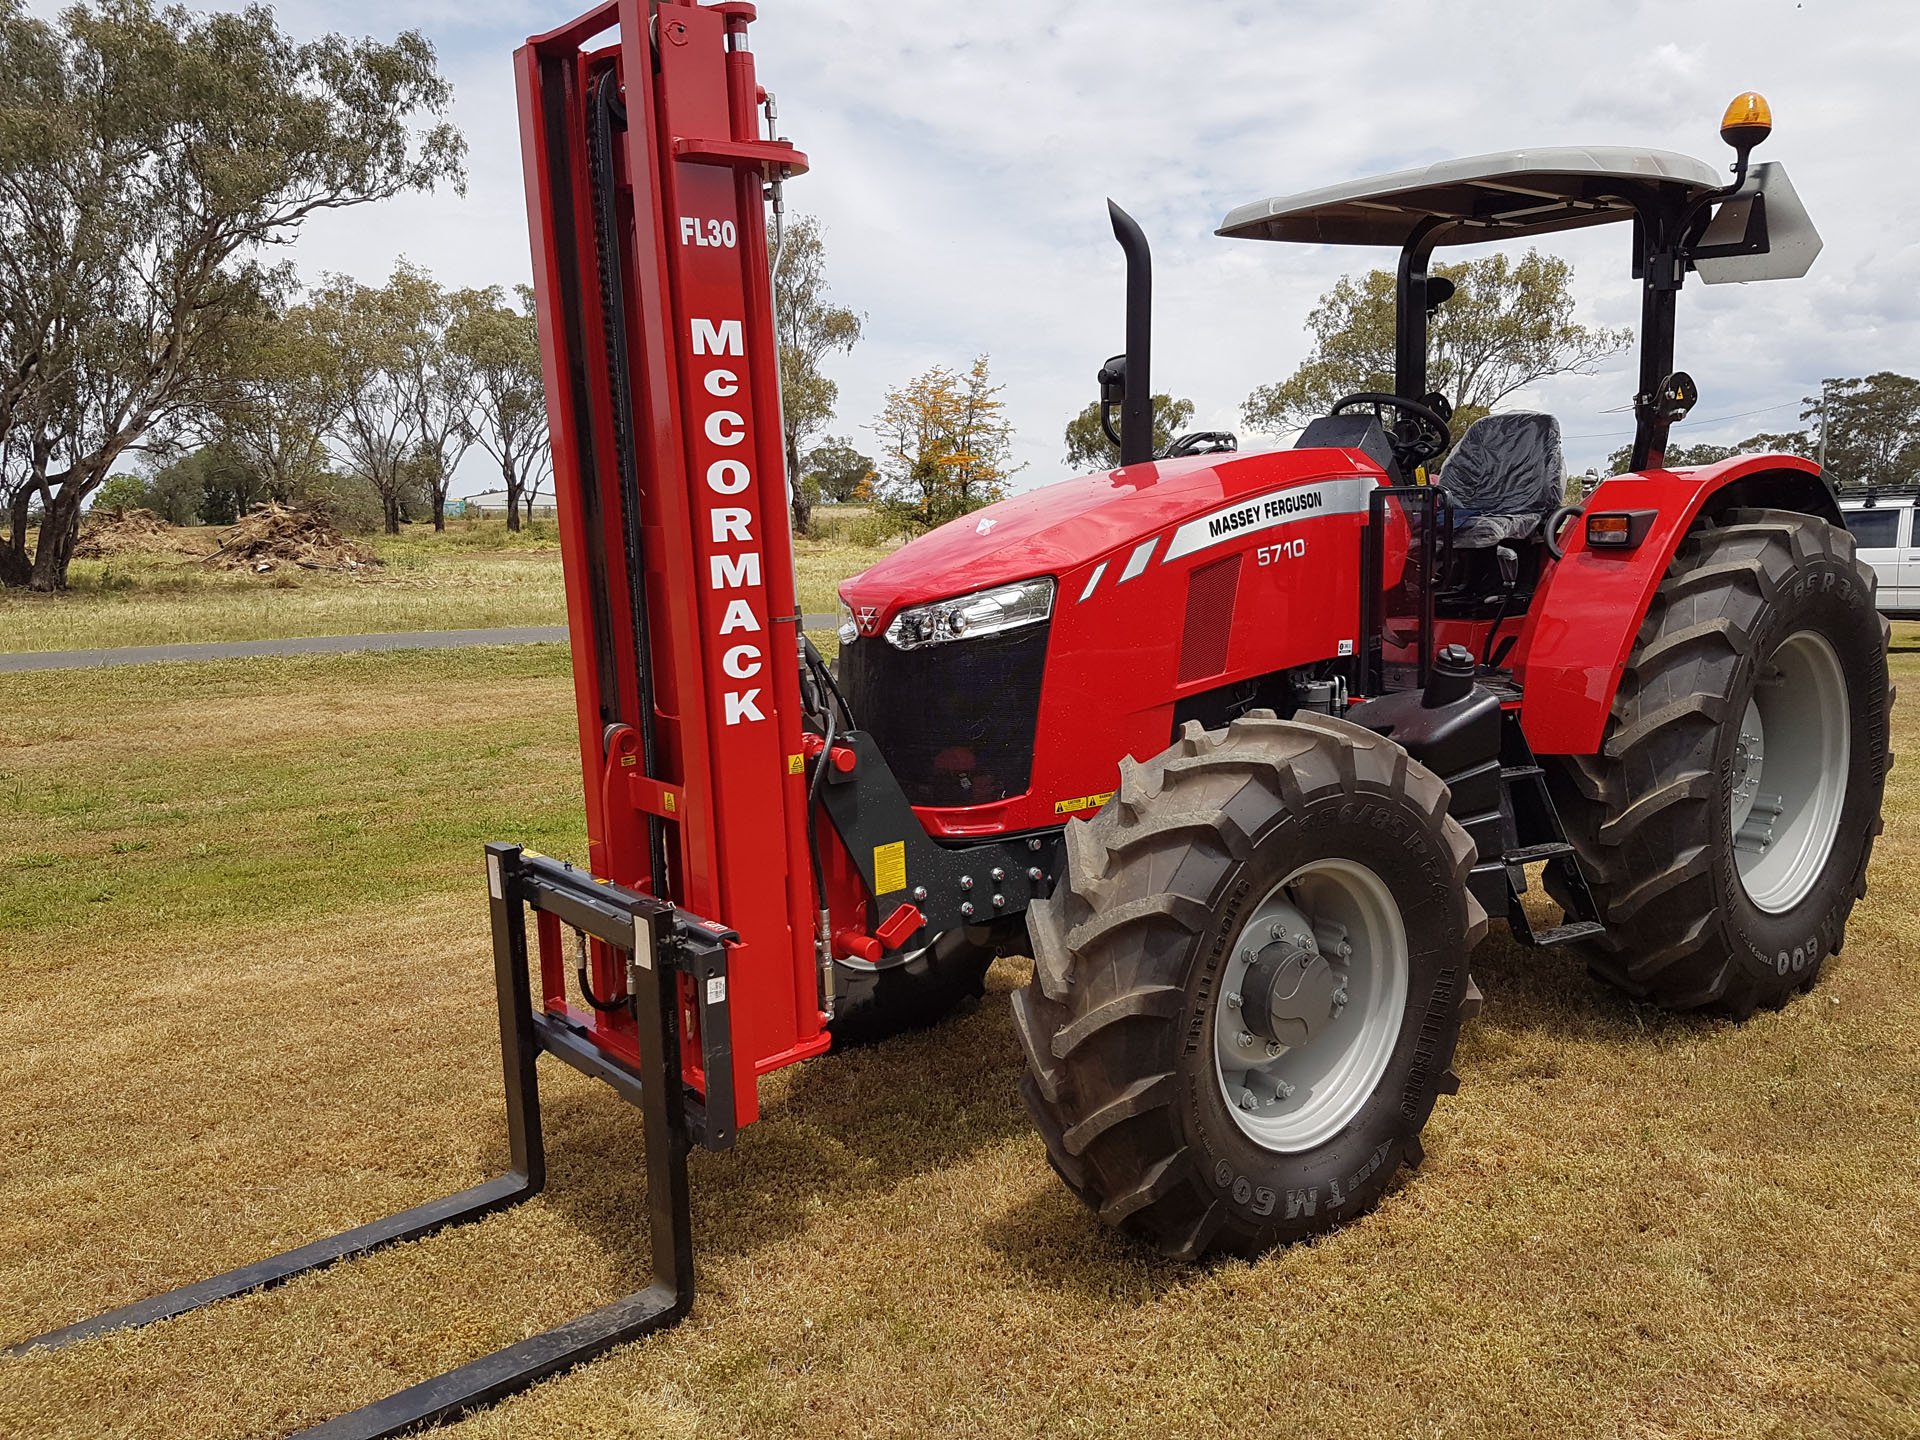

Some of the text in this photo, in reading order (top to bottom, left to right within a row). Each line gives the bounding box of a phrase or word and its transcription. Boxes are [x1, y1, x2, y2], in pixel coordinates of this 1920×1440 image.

[680, 216, 737, 249] FL30
[1208, 491, 1322, 538] MASSEY FERGUSON
[1257, 538, 1306, 567] 5710
[1182, 879, 1251, 1057] TRELLEBORG
[1401, 966, 1459, 1121] TRELLEBORG
